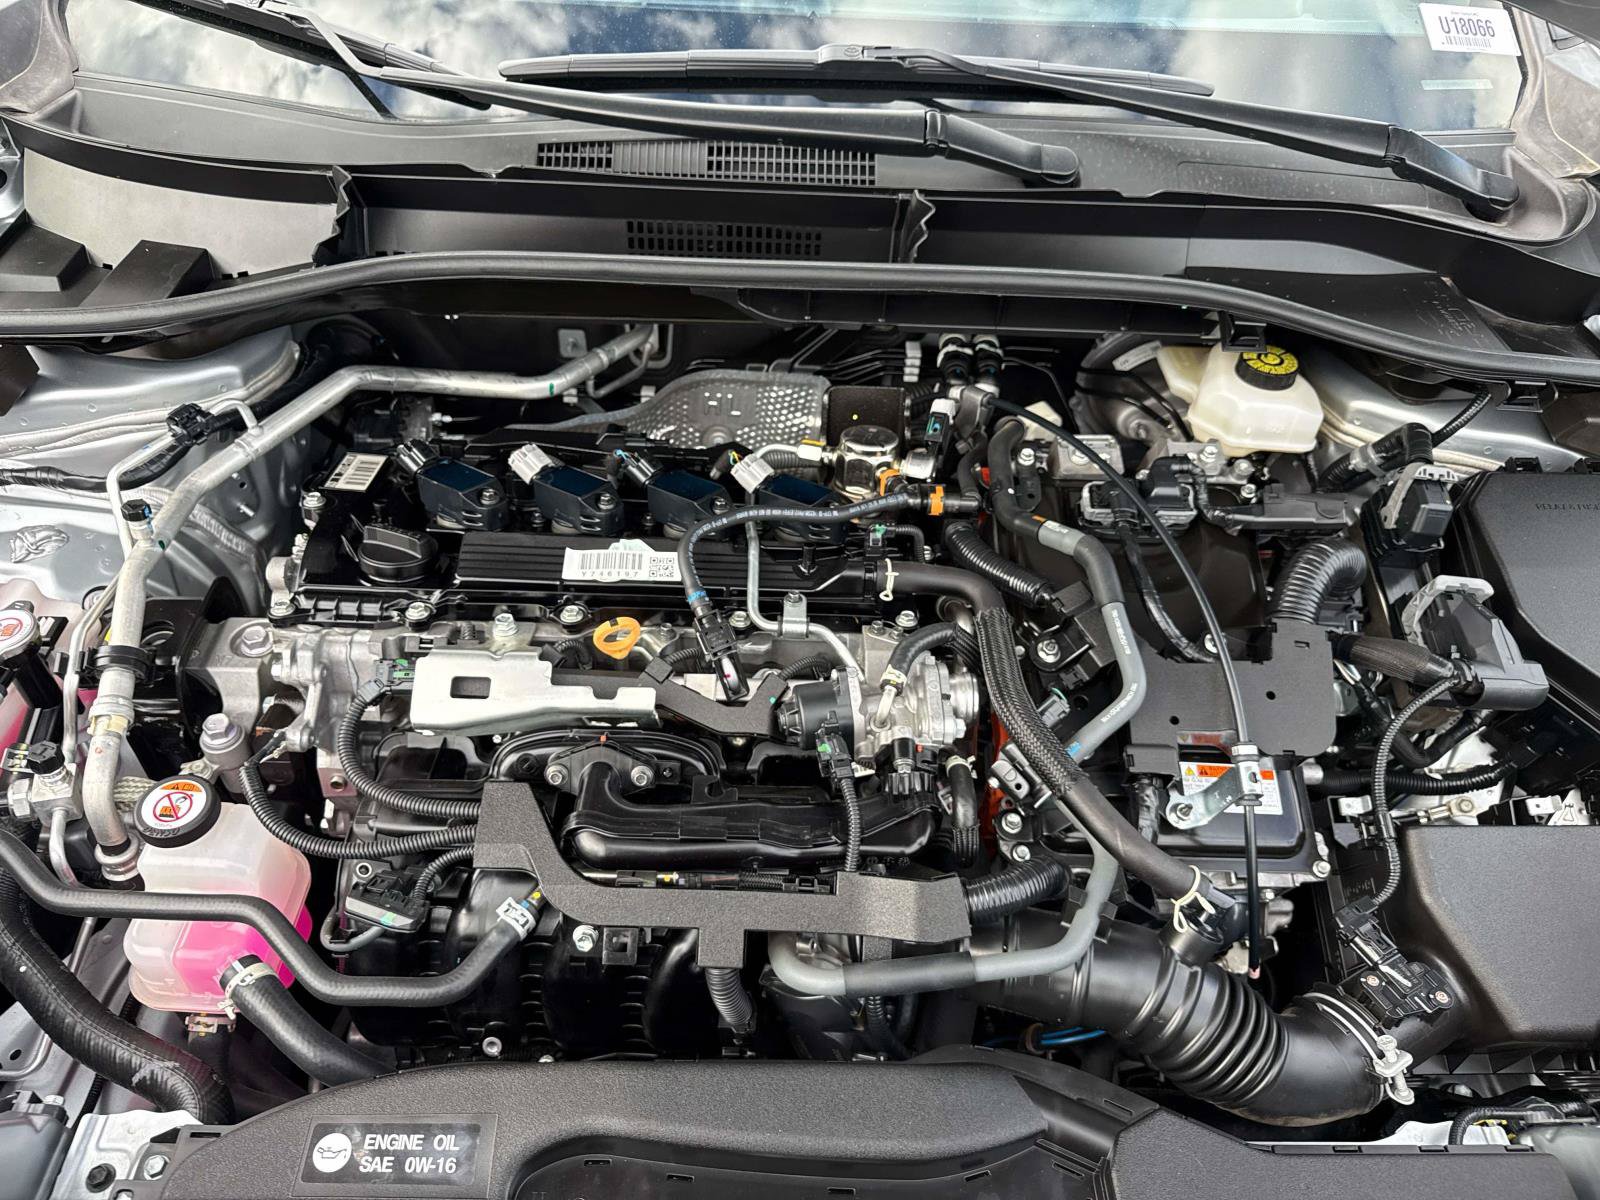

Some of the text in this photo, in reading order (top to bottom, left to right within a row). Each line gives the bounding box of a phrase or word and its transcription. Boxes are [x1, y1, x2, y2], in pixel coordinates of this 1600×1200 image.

[1438, 15, 1495, 37] U18066
[363, 1134, 460, 1151] ENGINE OIL
[359, 1156, 457, 1174] SAE 0W-16
